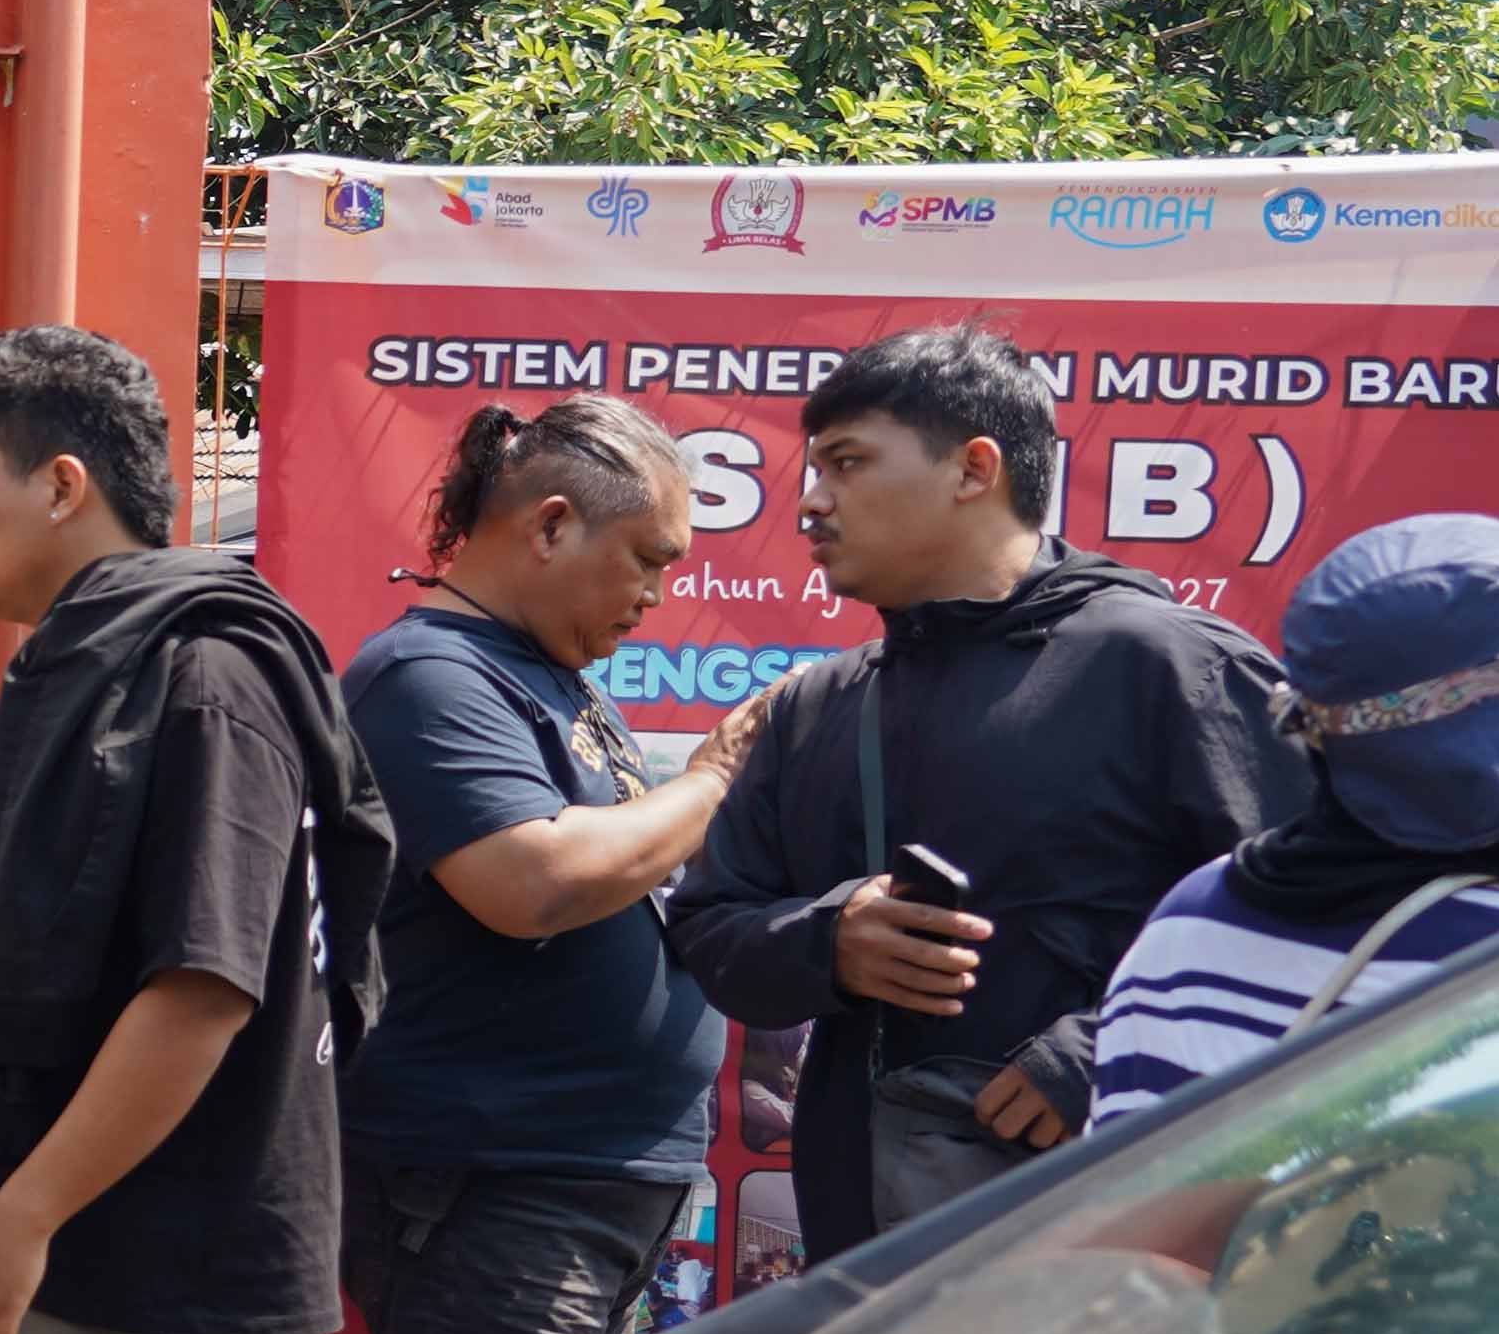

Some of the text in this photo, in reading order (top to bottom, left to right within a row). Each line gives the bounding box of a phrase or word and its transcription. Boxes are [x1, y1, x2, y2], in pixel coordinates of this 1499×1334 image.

[494, 191, 532, 204] Abad
[901, 195, 996, 222] SPMB
[1048, 194, 1216, 233] RAMAH
[369, 338, 602, 388] SISTEM
[1095, 355, 1327, 402] MURID
[1347, 359, 1499, 406] BAR
[664, 561, 785, 603] ahun
